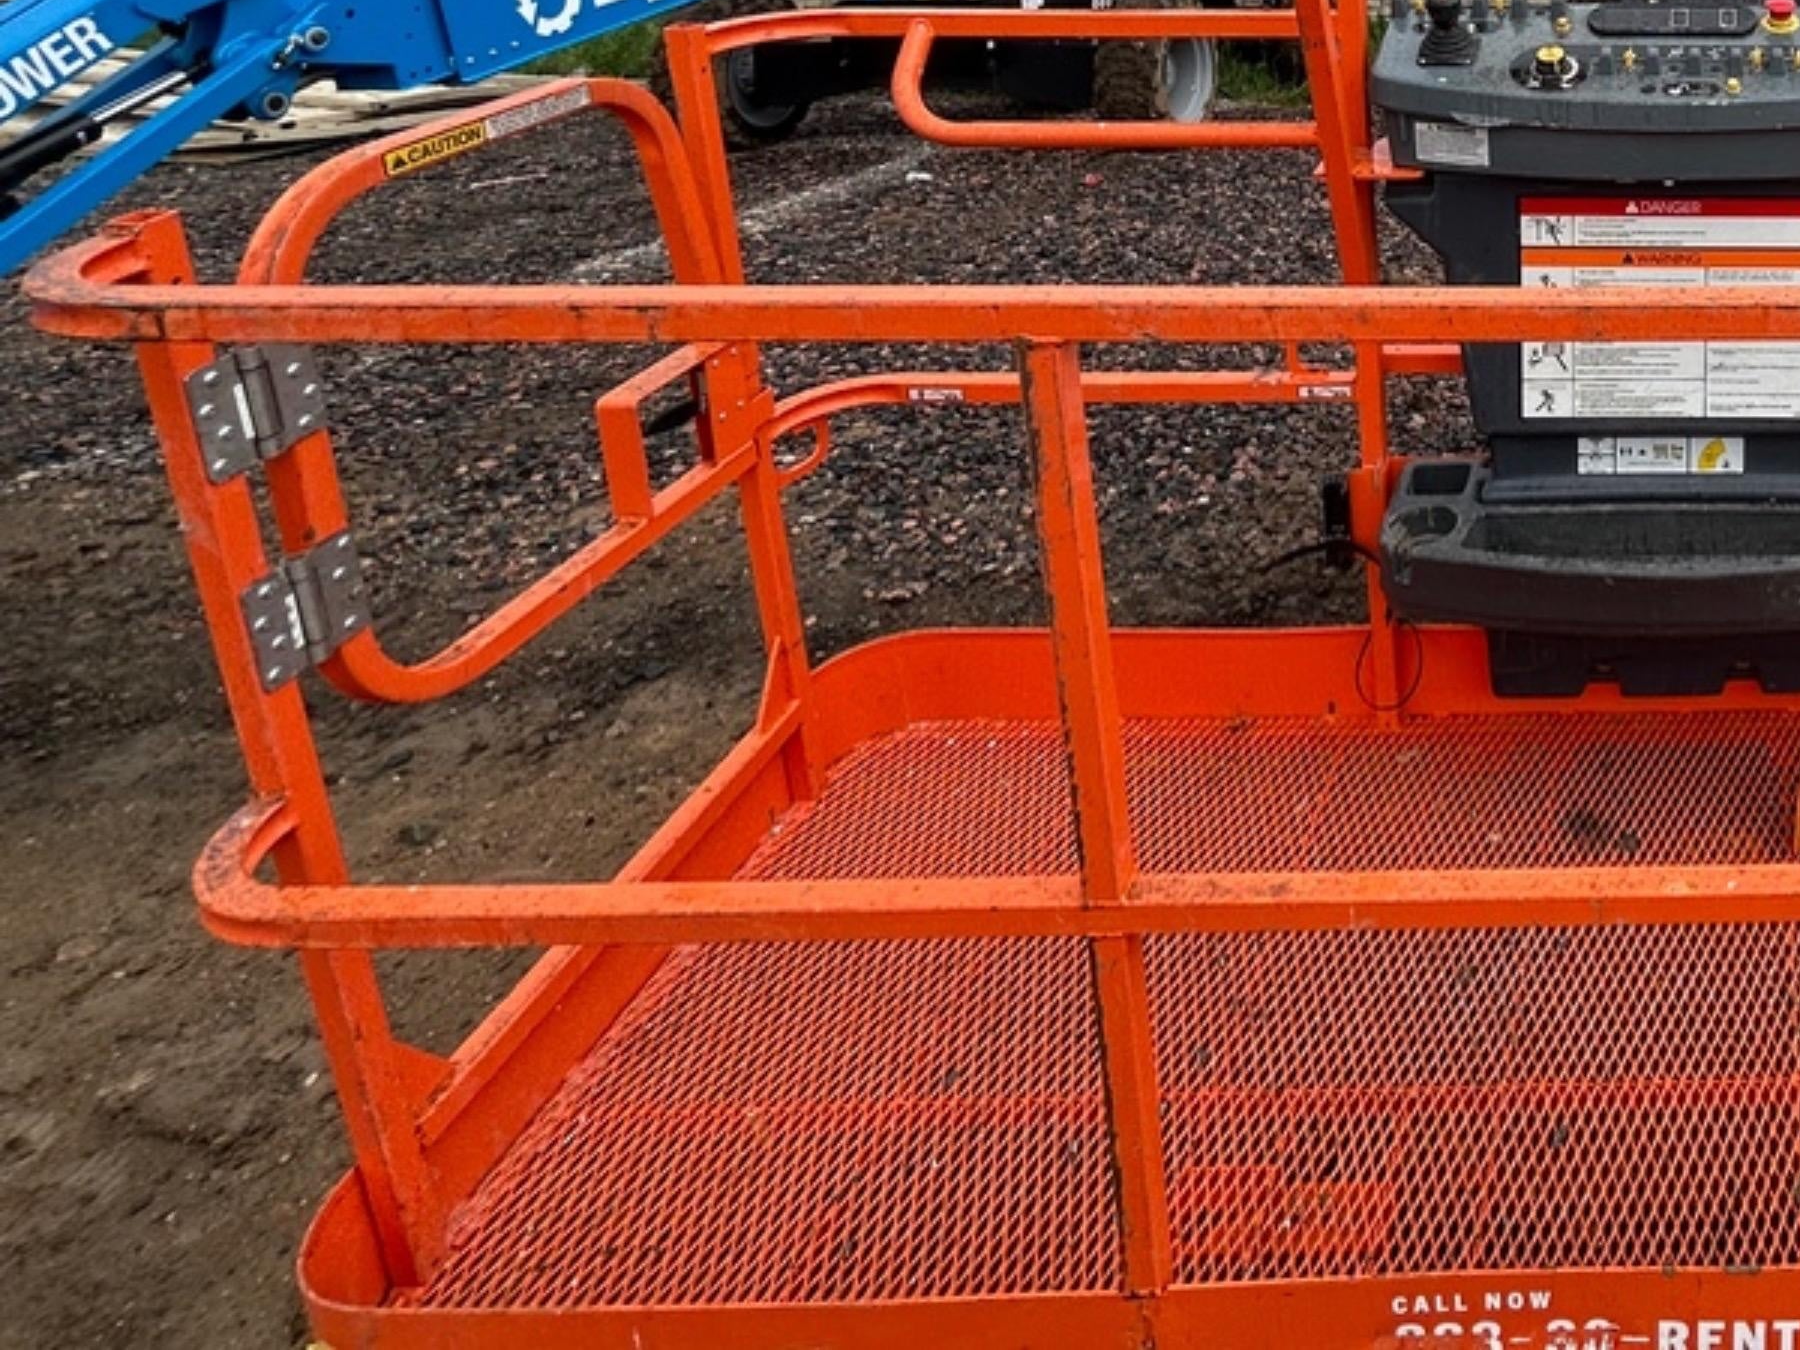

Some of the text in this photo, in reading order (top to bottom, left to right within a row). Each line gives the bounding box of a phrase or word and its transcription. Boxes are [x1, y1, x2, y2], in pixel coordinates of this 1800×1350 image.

[408, 125, 482, 163] CAUTION
[1640, 201, 1702, 214] DANGER
[1392, 1291, 1551, 1315] CALL NOW
